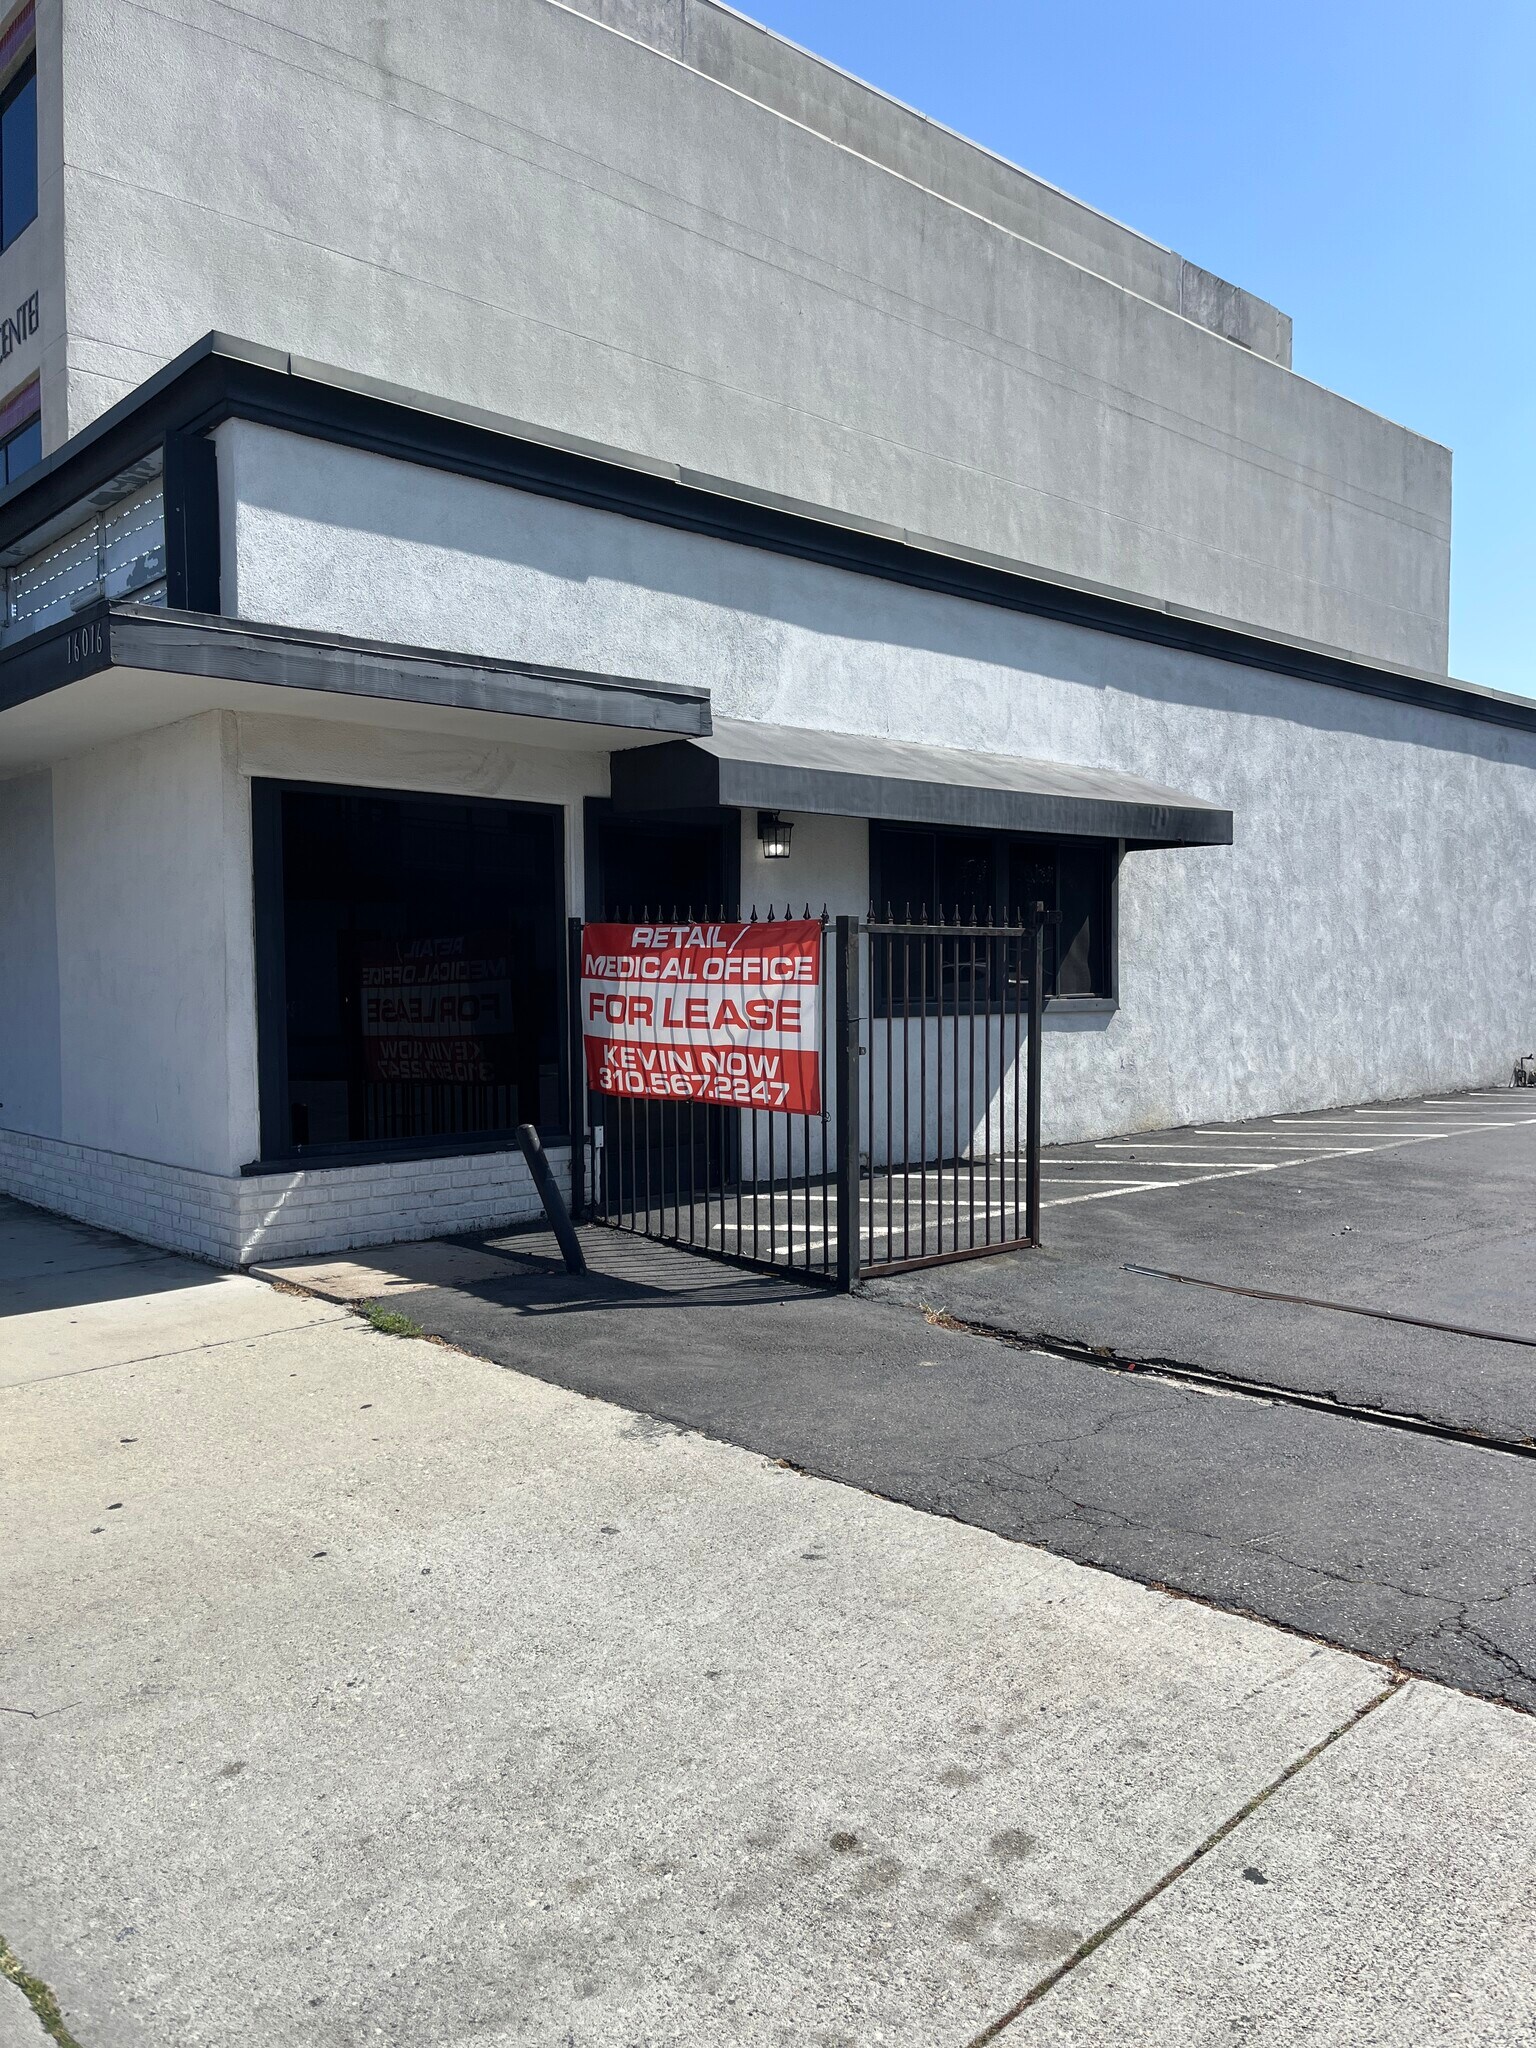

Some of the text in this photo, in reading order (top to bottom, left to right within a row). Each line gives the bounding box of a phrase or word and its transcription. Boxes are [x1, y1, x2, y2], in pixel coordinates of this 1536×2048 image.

[0, 289, 39, 365] ENTE
[67, 623, 102, 664] 16016
[631, 925, 751, 954] RETAIL/
[585, 954, 813, 981] MEDICAL OFFICE
[589, 992, 801, 1033] FOR LEASE
[603, 1044, 780, 1079] KEVIN NOW
[599, 1067, 790, 1106] 310.567.2247
